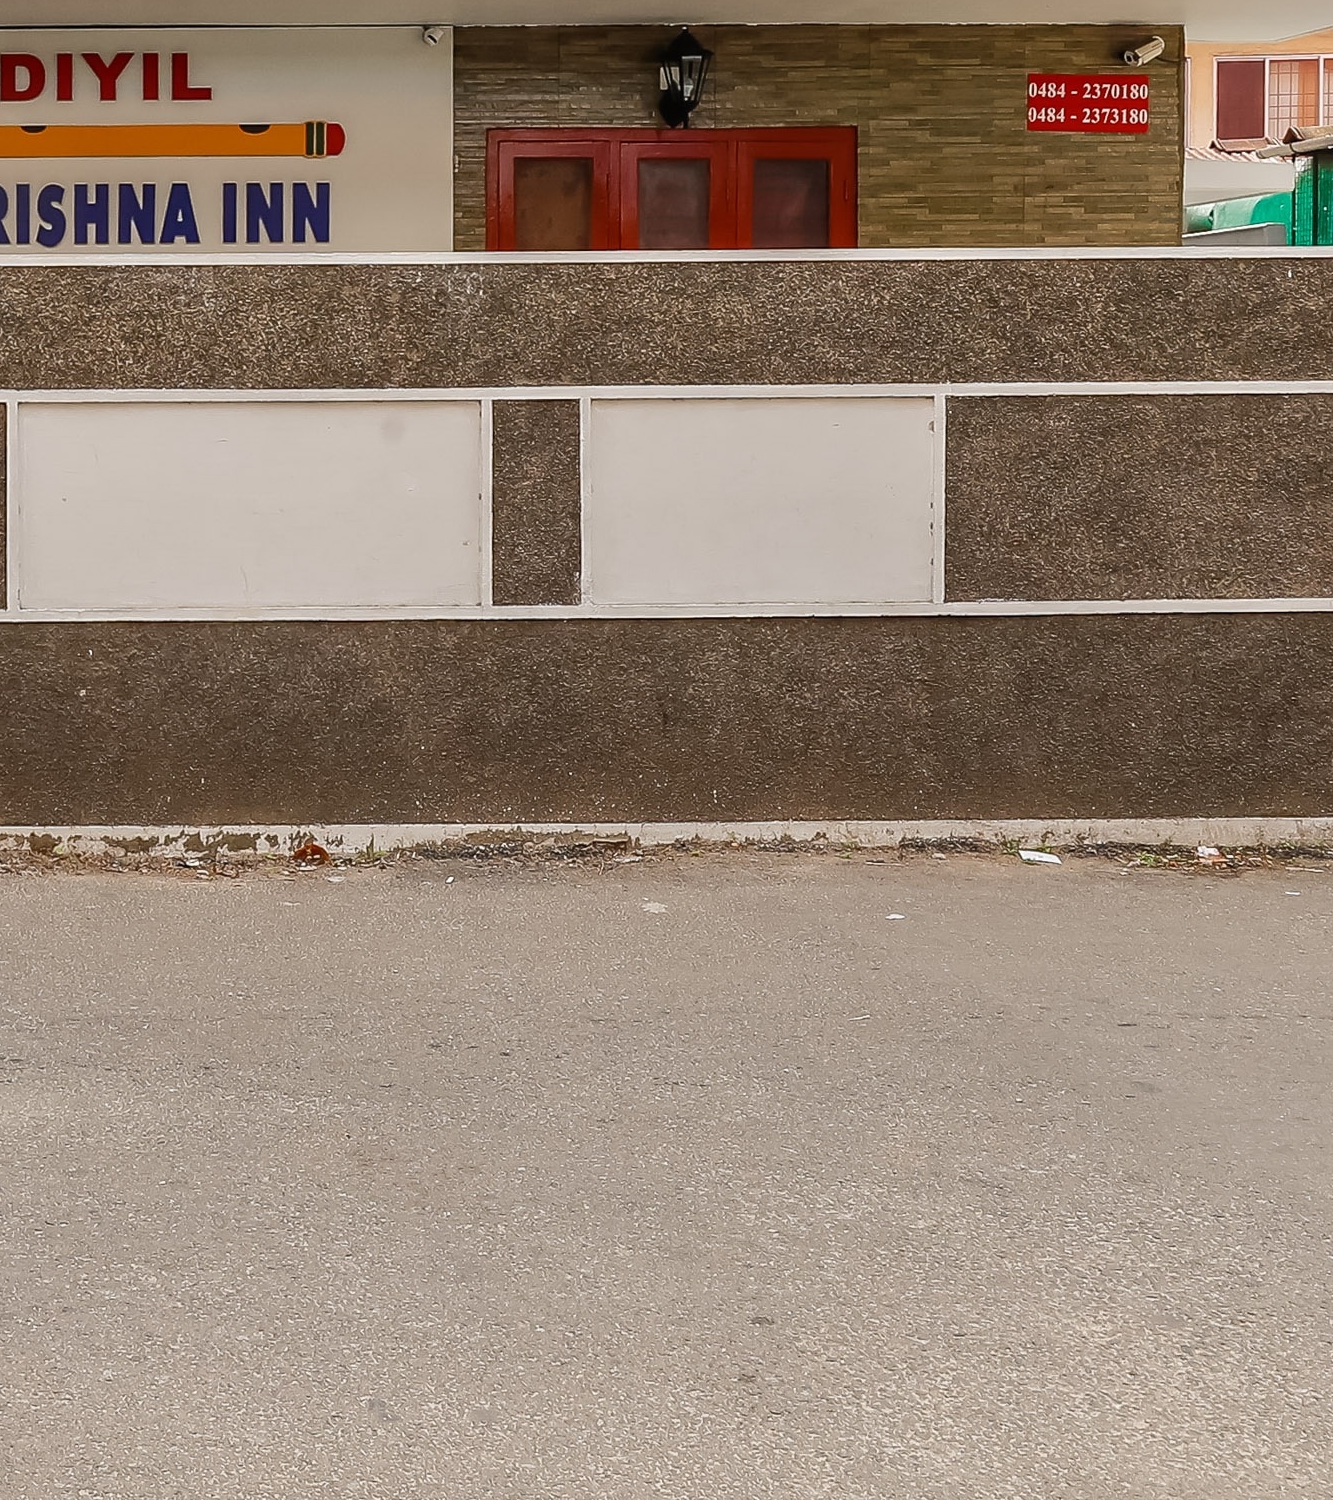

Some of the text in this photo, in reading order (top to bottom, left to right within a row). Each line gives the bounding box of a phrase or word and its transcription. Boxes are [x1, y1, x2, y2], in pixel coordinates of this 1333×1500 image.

[1028, 82, 1066, 98] 0484
[1082, 83, 1149, 100] 2370180
[1027, 107, 1065, 123] 0484
[1082, 108, 1148, 124] 2373180
[221, 182, 331, 244] INN
